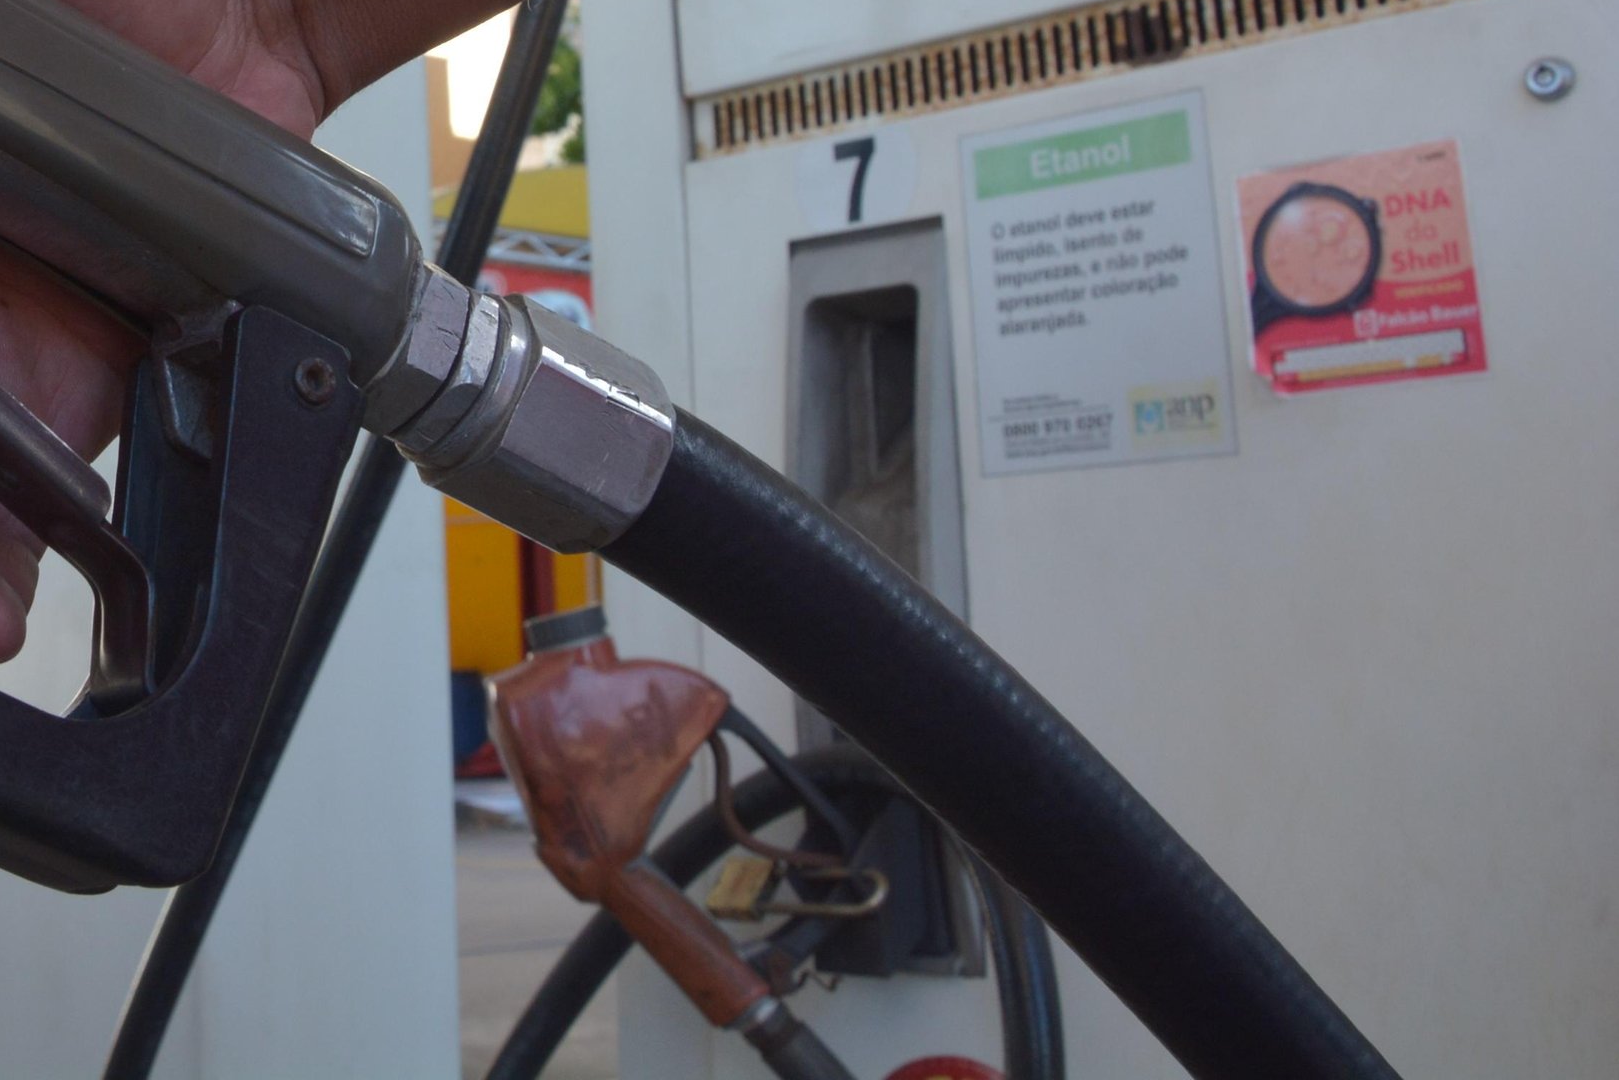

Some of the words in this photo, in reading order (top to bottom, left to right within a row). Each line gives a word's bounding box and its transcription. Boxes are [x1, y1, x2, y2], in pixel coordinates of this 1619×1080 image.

[1030, 134, 1132, 180] Etanol
[833, 136, 876, 224] 7
[990, 222, 1006, 242] O
[1009, 214, 1062, 238] etanol
[1066, 208, 1107, 230] deve
[1111, 200, 1156, 222] estar
[1385, 187, 1451, 217] DNA
[1064, 230, 1119, 253] isento
[1122, 226, 1146, 245] de
[1391, 240, 1461, 274] Shell
[1090, 261, 1103, 274] e
[1106, 253, 1140, 272] não
[1143, 244, 1190, 269] pode
[996, 285, 1086, 314] apresentar
[1090, 271, 1180, 300] coloração
